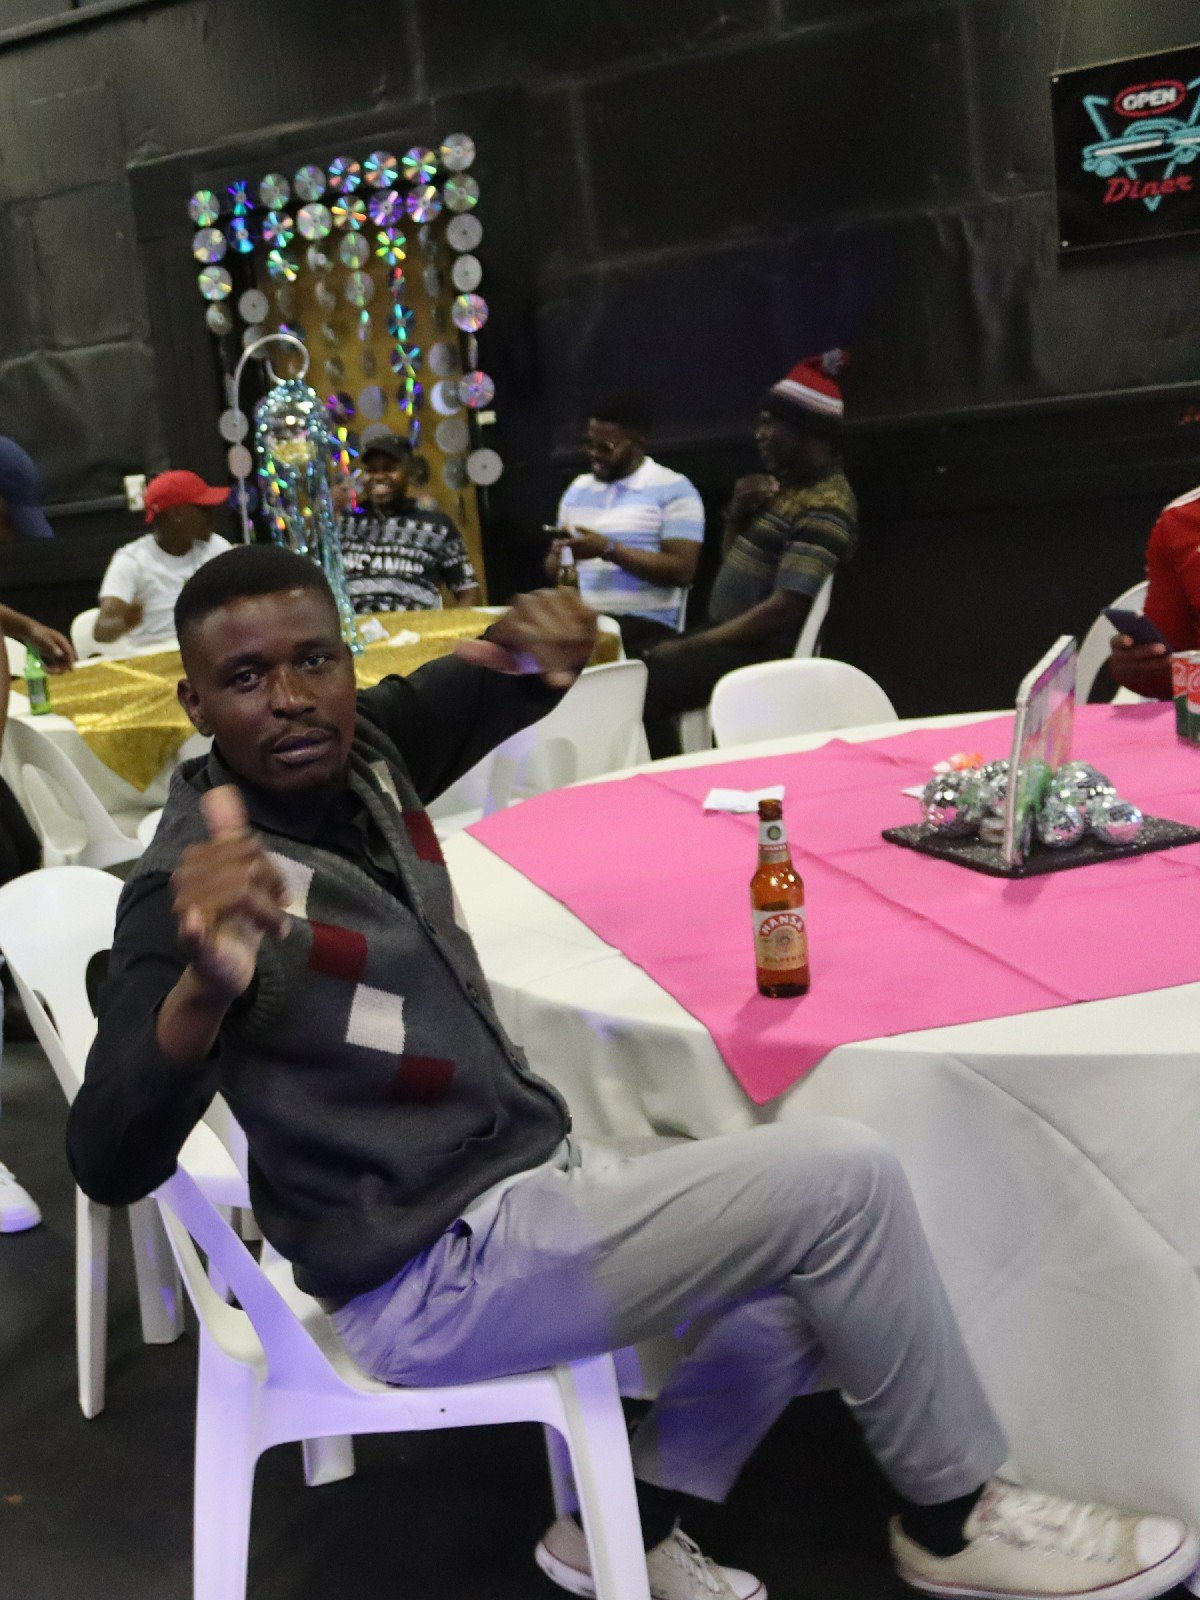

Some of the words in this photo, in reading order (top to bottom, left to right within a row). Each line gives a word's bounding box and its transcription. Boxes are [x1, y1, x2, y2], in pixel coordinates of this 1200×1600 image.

[1122, 88, 1177, 110] OPEN
[1103, 175, 1193, 204] Diner
[761, 914, 803, 934] HANSA
